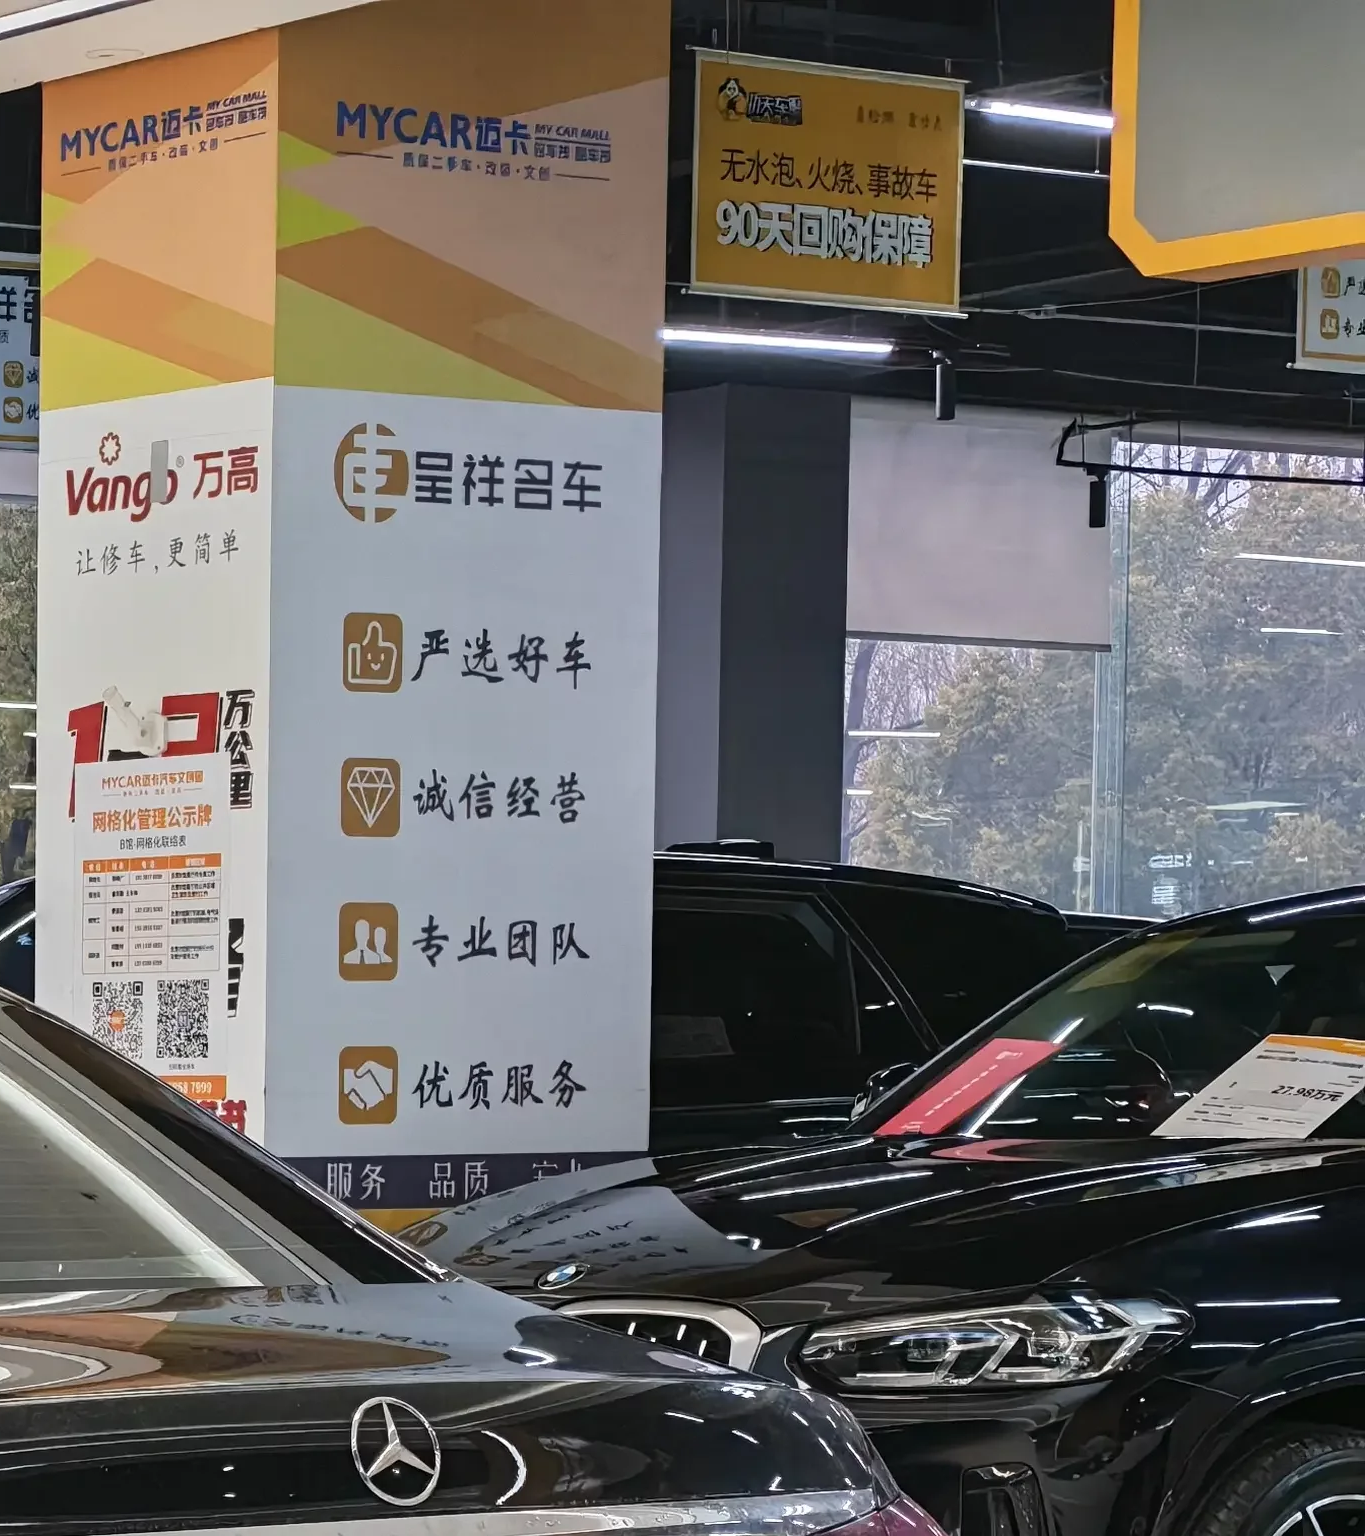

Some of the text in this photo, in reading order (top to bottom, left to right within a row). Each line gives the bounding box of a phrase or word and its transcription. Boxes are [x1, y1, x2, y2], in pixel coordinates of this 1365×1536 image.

[720, 148, 938, 202] 无水泡、火烧、事故车
[716, 199, 935, 268] 90天回购保障
[192, 445, 259, 500] 万高
[415, 450, 603, 513] 呈祥名车
[411, 629, 593, 690] 严选好车
[92, 804, 213, 833] 网格化管理公示牌
[412, 769, 587, 825] 诚信经营
[412, 915, 591, 968] 专业团队
[412, 1060, 588, 1112] 优质服务
[327, 1162, 386, 1200] 服务
[429, 1160, 490, 1200] 品质
